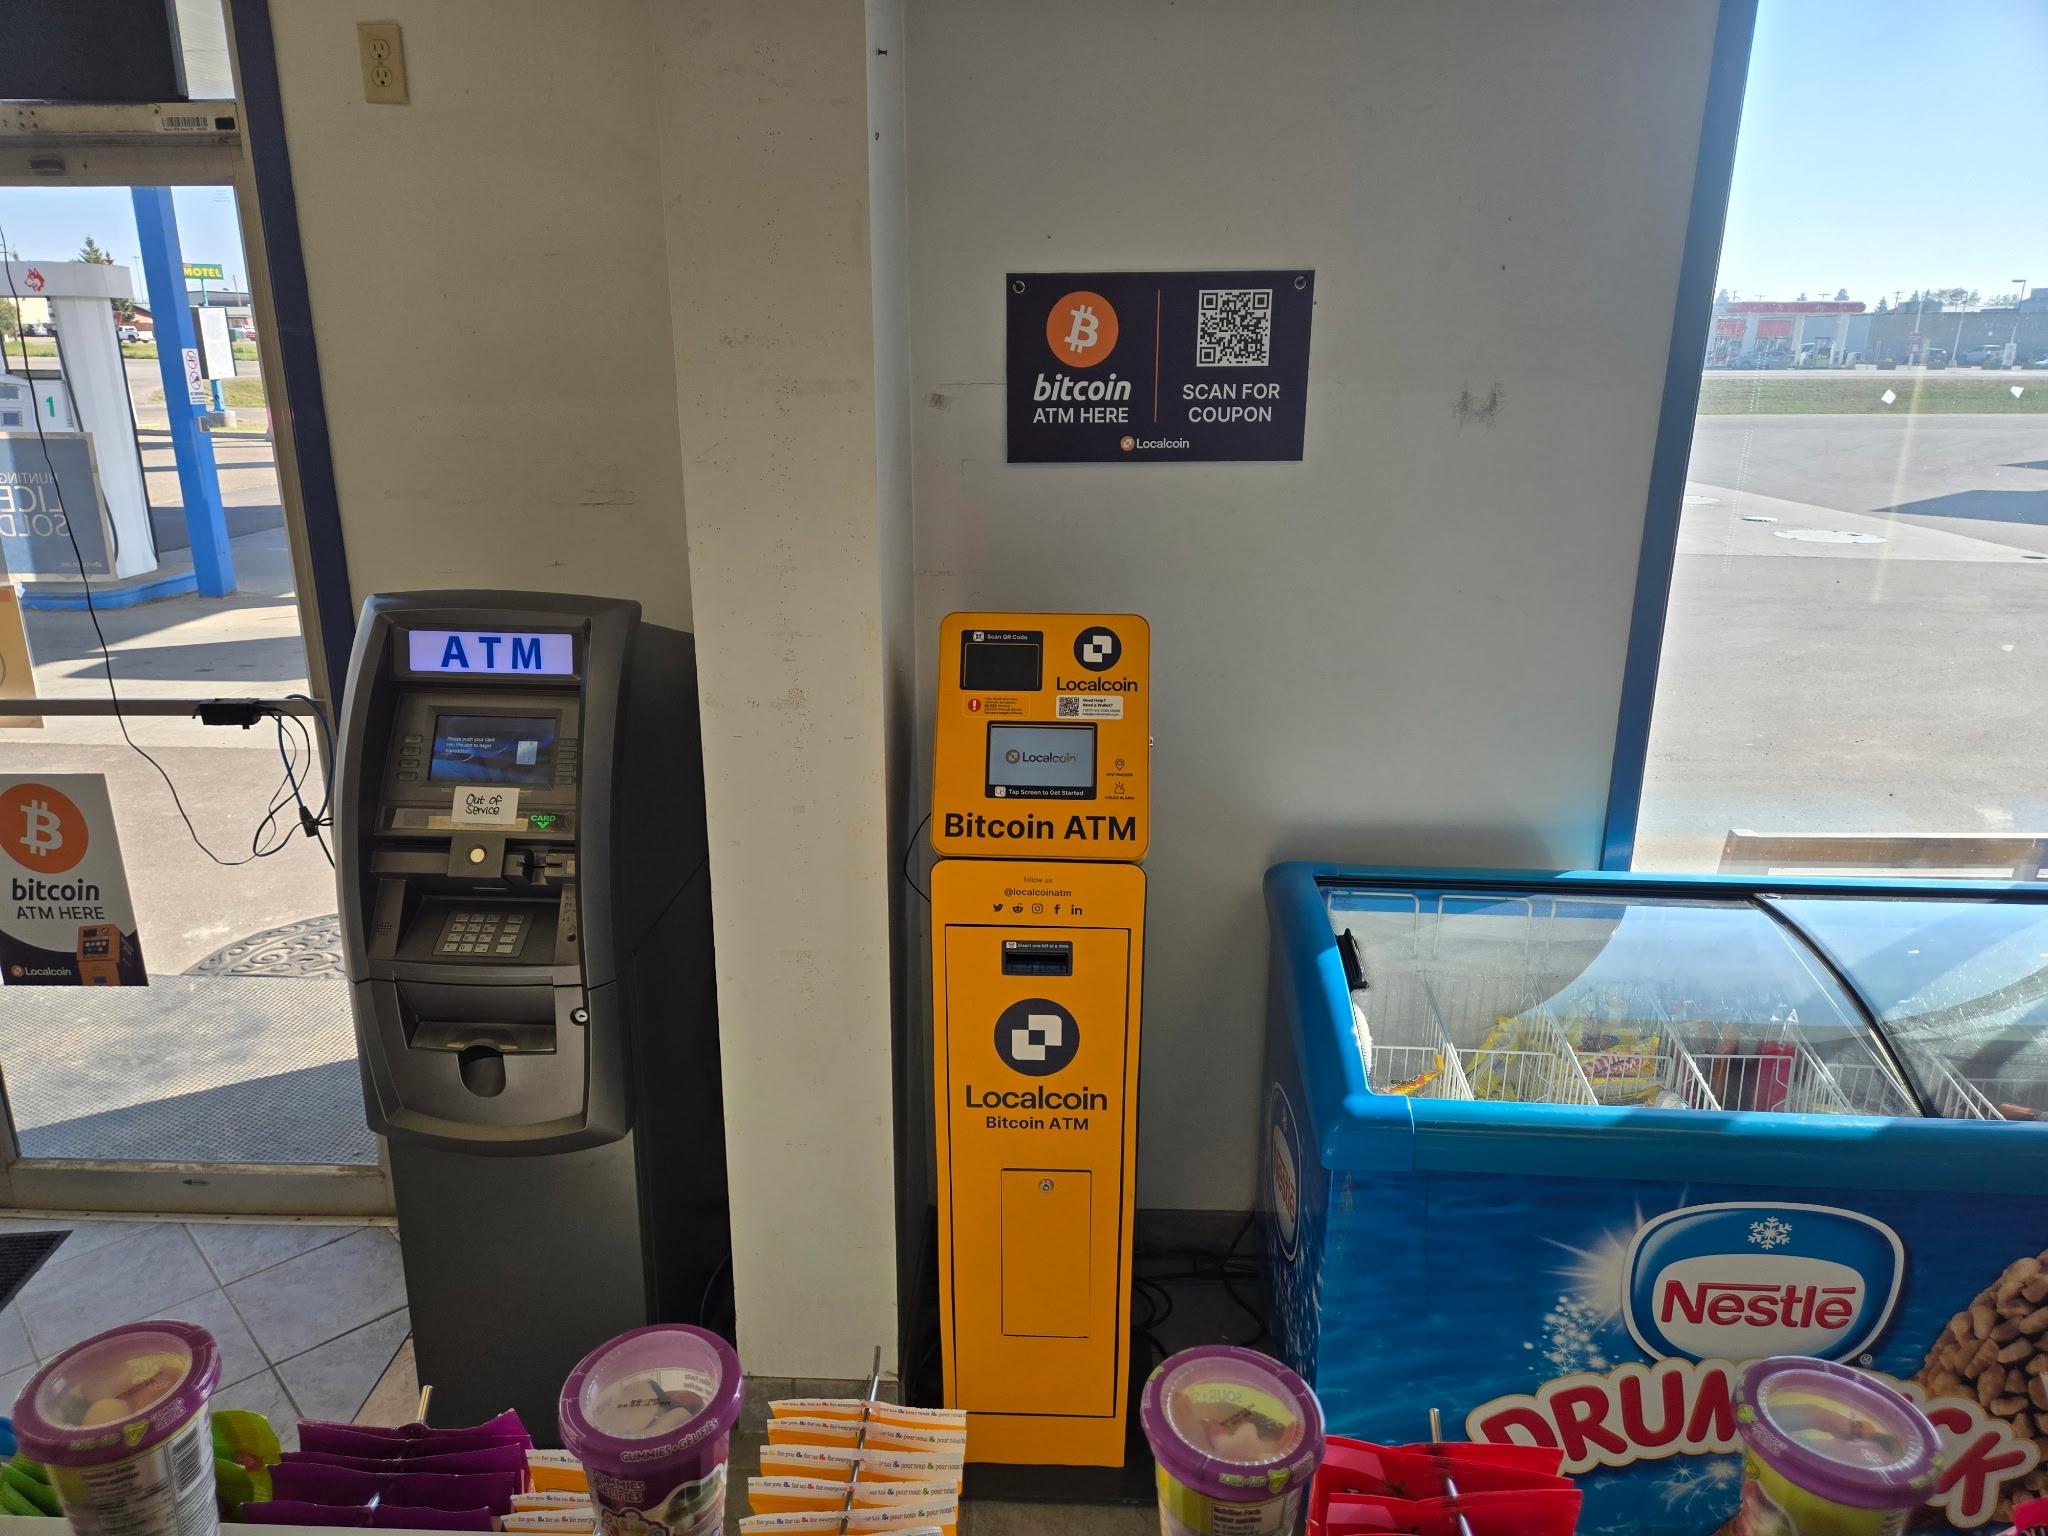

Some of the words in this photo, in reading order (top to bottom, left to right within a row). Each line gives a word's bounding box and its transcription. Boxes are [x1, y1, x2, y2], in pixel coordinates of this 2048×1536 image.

[184, 267, 222, 278] MOTEL
[1033, 373, 1131, 401] bitcoin
[1182, 383, 1236, 400] SCAN
[1242, 383, 1280, 400] FOR
[46, 396, 55, 417] 1
[1188, 406, 1272, 423] COUPON
[1033, 408, 1073, 424] ATM
[1080, 408, 1129, 424] HERE
[1136, 438, 1190, 450] Localcoin
[441, 635, 542, 670] ATM
[1056, 676, 1138, 692] Localcoin
[1022, 752, 1076, 763] Localcoin
[466, 794, 485, 804] Out
[488, 794, 502, 805] of
[944, 812, 1054, 839] Bitcoin
[1064, 816, 1136, 841] ATM
[12, 878, 100, 901] bitcoin
[1004, 888, 1072, 897] @localcoinatm
[17, 906, 54, 920] ATM
[59, 906, 104, 920] HERE
[25, 966, 72, 976] Localcoin
[966, 1084, 1107, 1110] Localcoin
[986, 1116, 1044, 1129] Bitcoin
[1050, 1118, 1088, 1130] ATM
[621, 1444, 672, 1462] GUMMIES
